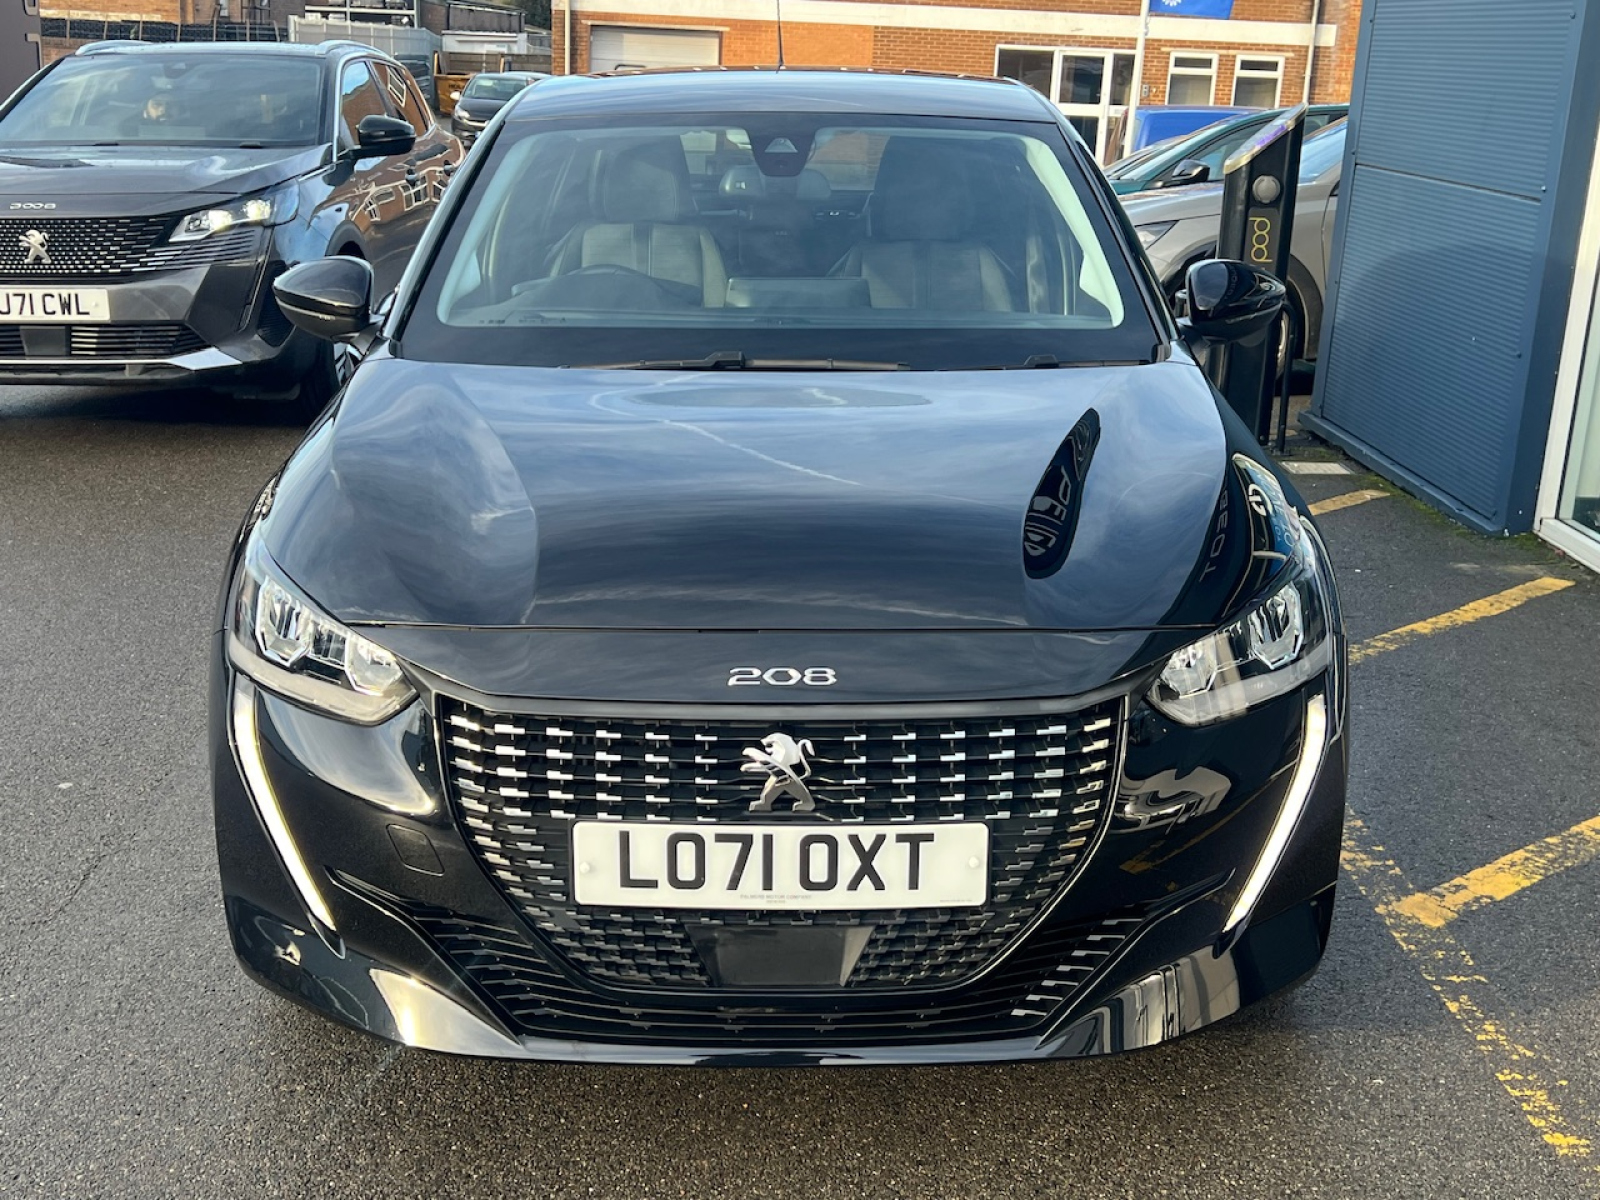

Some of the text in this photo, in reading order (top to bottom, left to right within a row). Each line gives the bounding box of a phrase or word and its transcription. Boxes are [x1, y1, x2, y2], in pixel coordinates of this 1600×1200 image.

[1249, 217, 1271, 262] pod
[42, 293, 90, 315] CWL
[727, 666, 837, 686] 208
[618, 830, 935, 891] LO71 OXT
